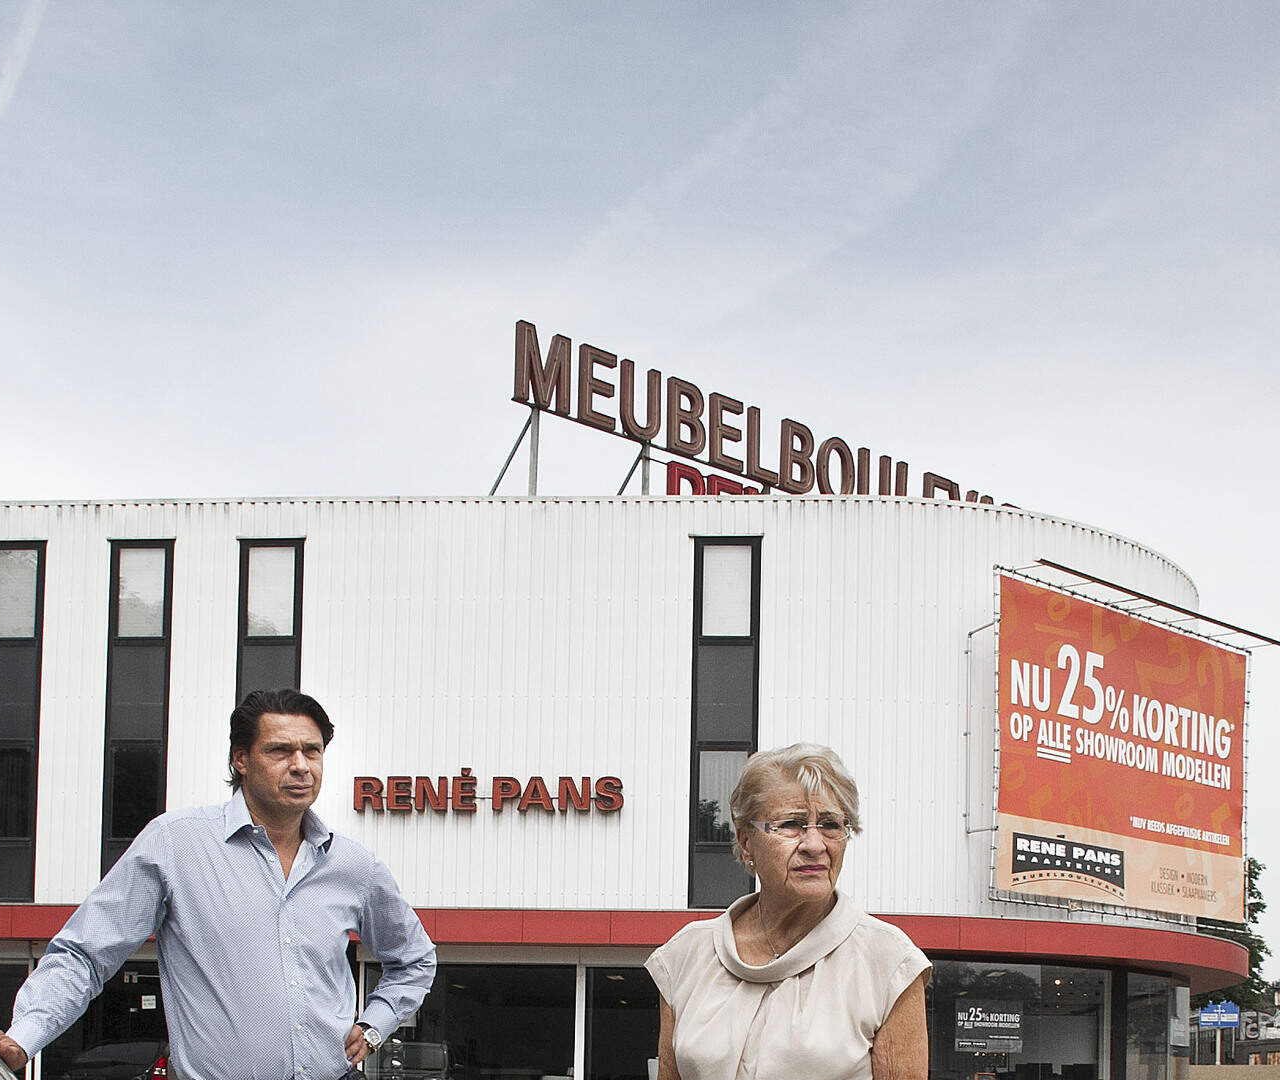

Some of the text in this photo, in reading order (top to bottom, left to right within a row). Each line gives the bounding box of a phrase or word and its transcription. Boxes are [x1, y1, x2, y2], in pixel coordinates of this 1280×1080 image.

[513, 320, 1020, 509] MEUBELBOU
[1010, 658, 1051, 712] NU
[1010, 711, 1231, 791] OP ALLE SHOWROOM MODELLEN
[353, 767, 625, 813] RENÉ PANS
[1016, 854, 1121, 876] MAASTRICHT
[1072, 846, 1121, 867] PANS
[1012, 872, 1125, 898] MEUBELBOULEVARD
[957, 1012, 968, 1021] NU
